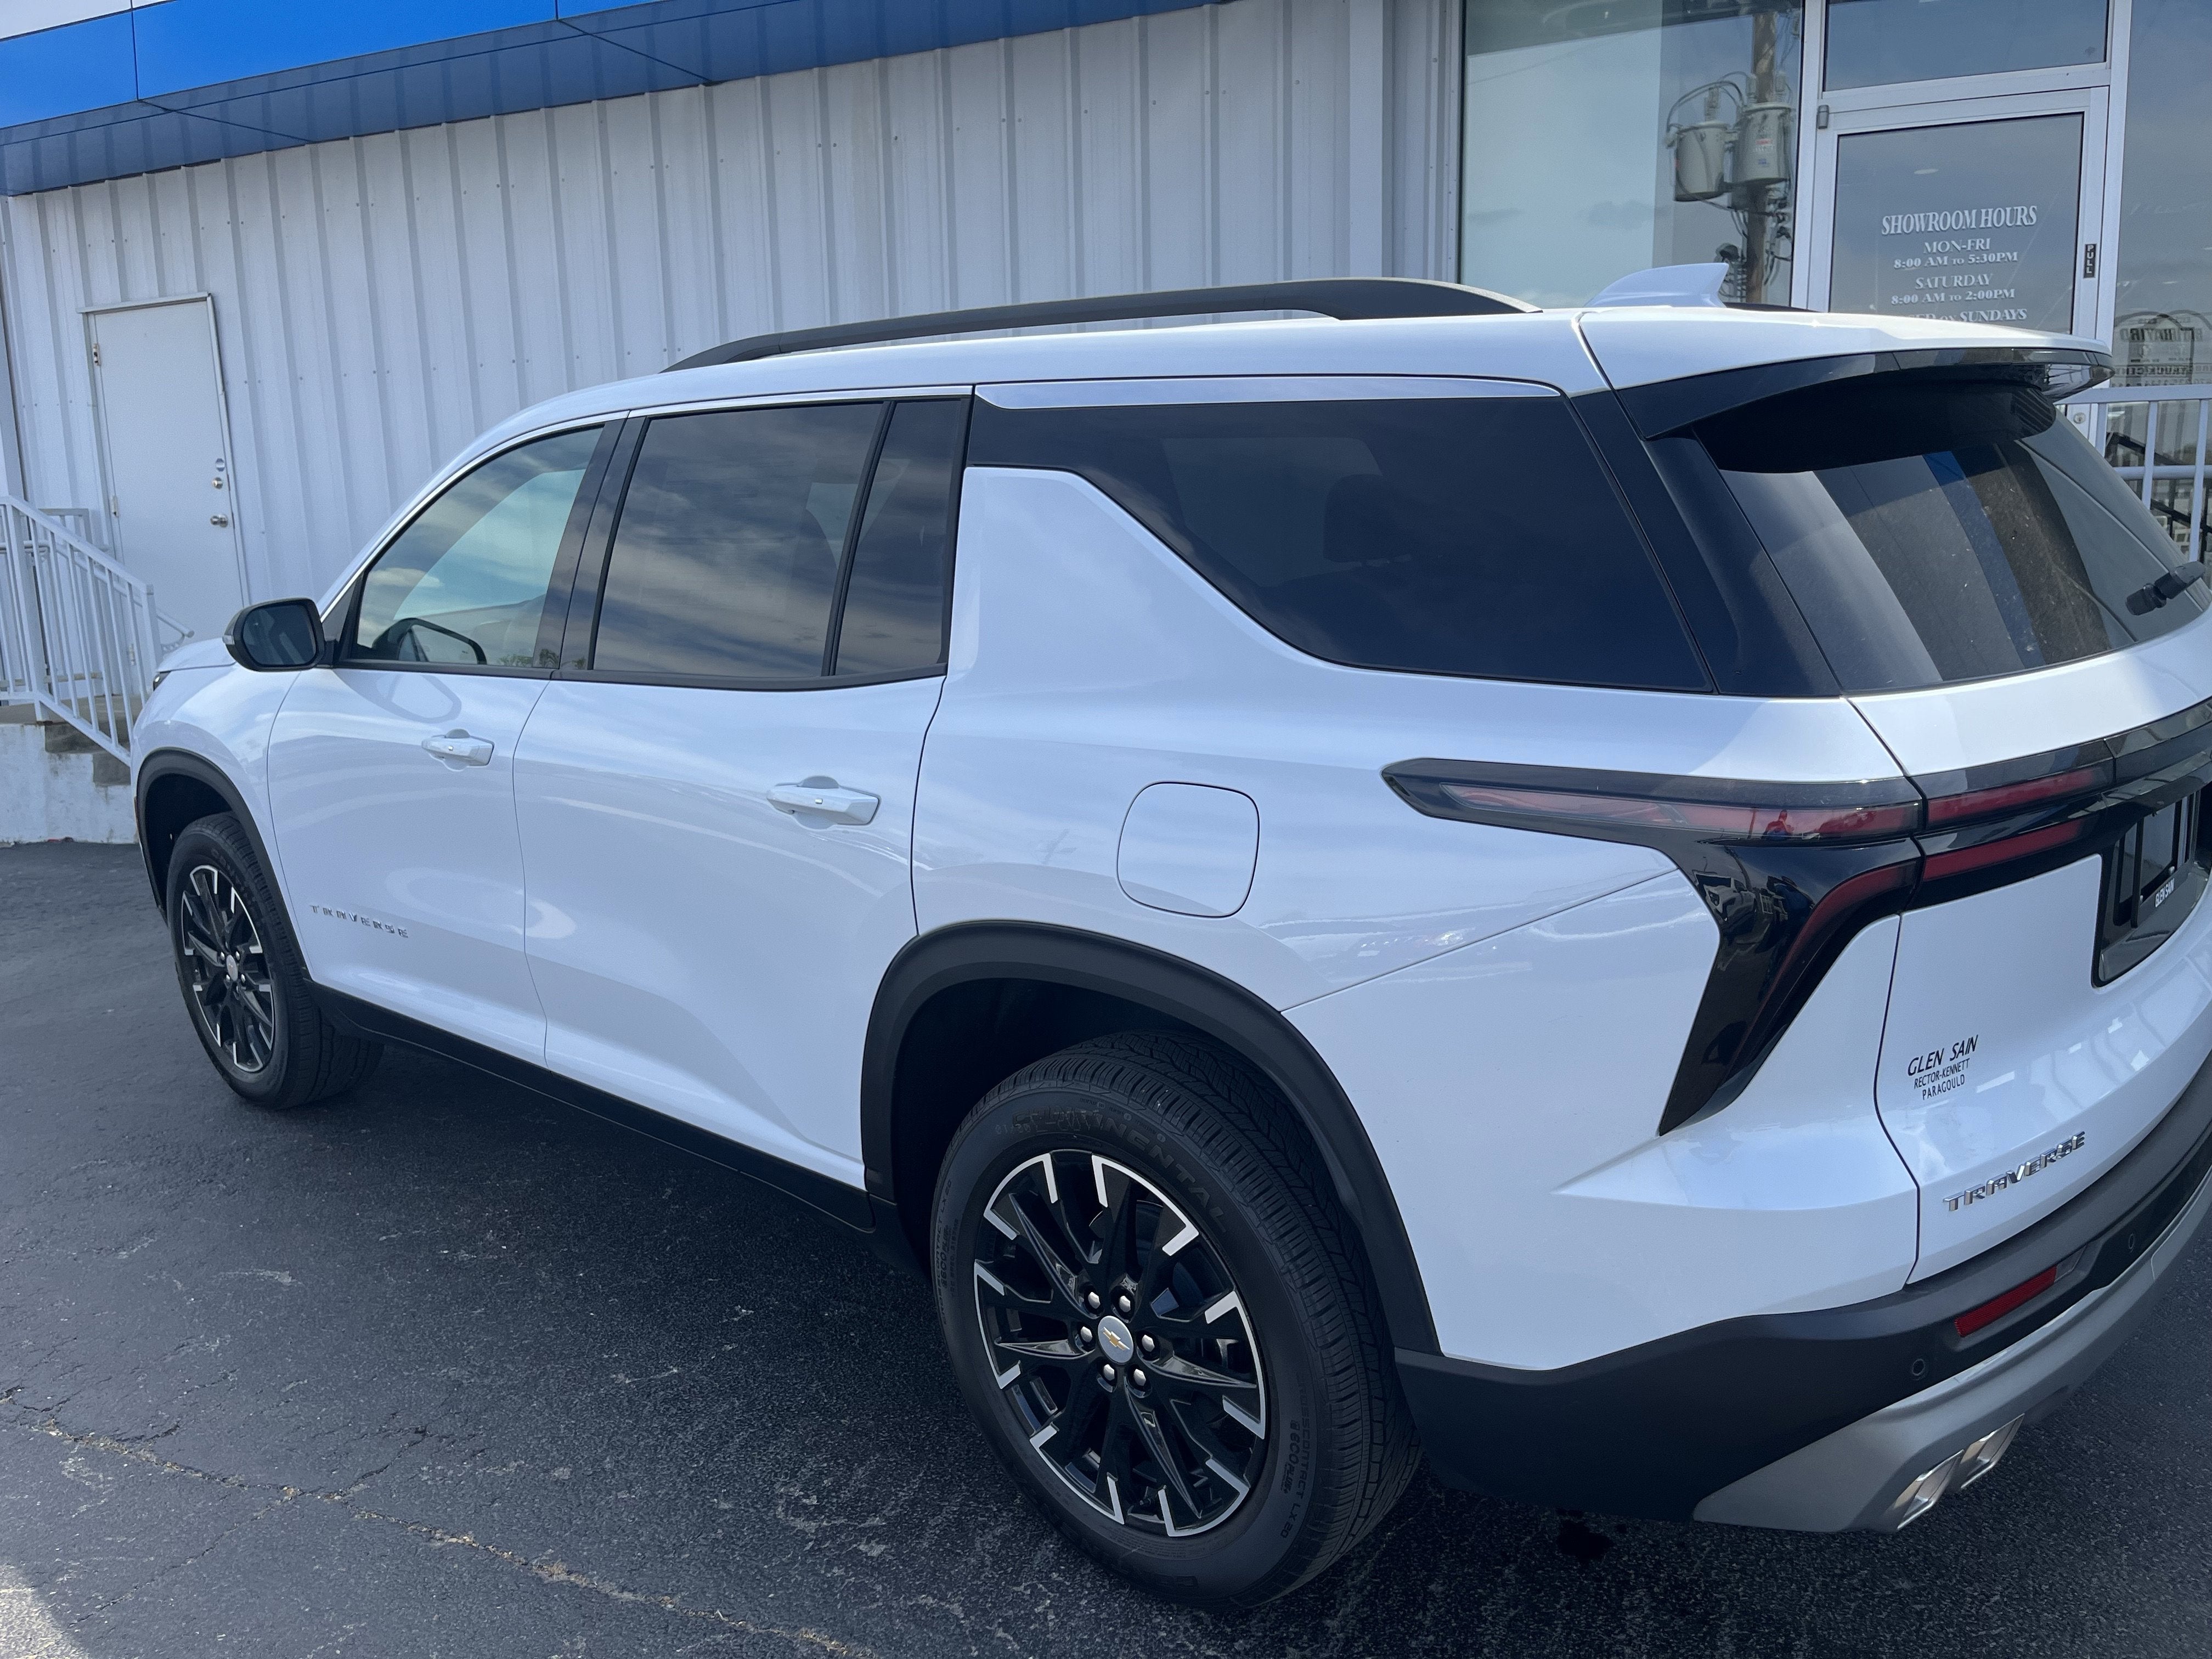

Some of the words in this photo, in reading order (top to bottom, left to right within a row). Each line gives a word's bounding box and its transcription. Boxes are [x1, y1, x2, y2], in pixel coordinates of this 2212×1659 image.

[1882, 210, 1976, 235] SHOWROOM
[1979, 206, 2037, 228] HOURS
[1923, 238, 1991, 253] MON-FRI
[2086, 245, 2094, 273] PULL
[1894, 258, 1921, 268] 8:00
[1924, 256, 1948, 266] AM
[1968, 252, 2018, 264] 5:30PM
[1915, 274, 1993, 290] SATURDAY
[1891, 295, 1918, 305] 8:00
[1922, 292, 1945, 303] AM
[1965, 289, 2016, 301] 2:00PM
[1960, 308, 2028, 322] SUNDAYS
[309, 905, 409, 938] TRAVERSE
[1908, 1047, 1945, 1076] GLEN
[1949, 1034, 1979, 1062] SAIN
[1914, 1058, 1971, 1090] RECTOR-KENNETT
[1922, 1074, 1965, 1101] PARAGOULD
[1943, 1131, 2085, 1212] TRAVERSE
